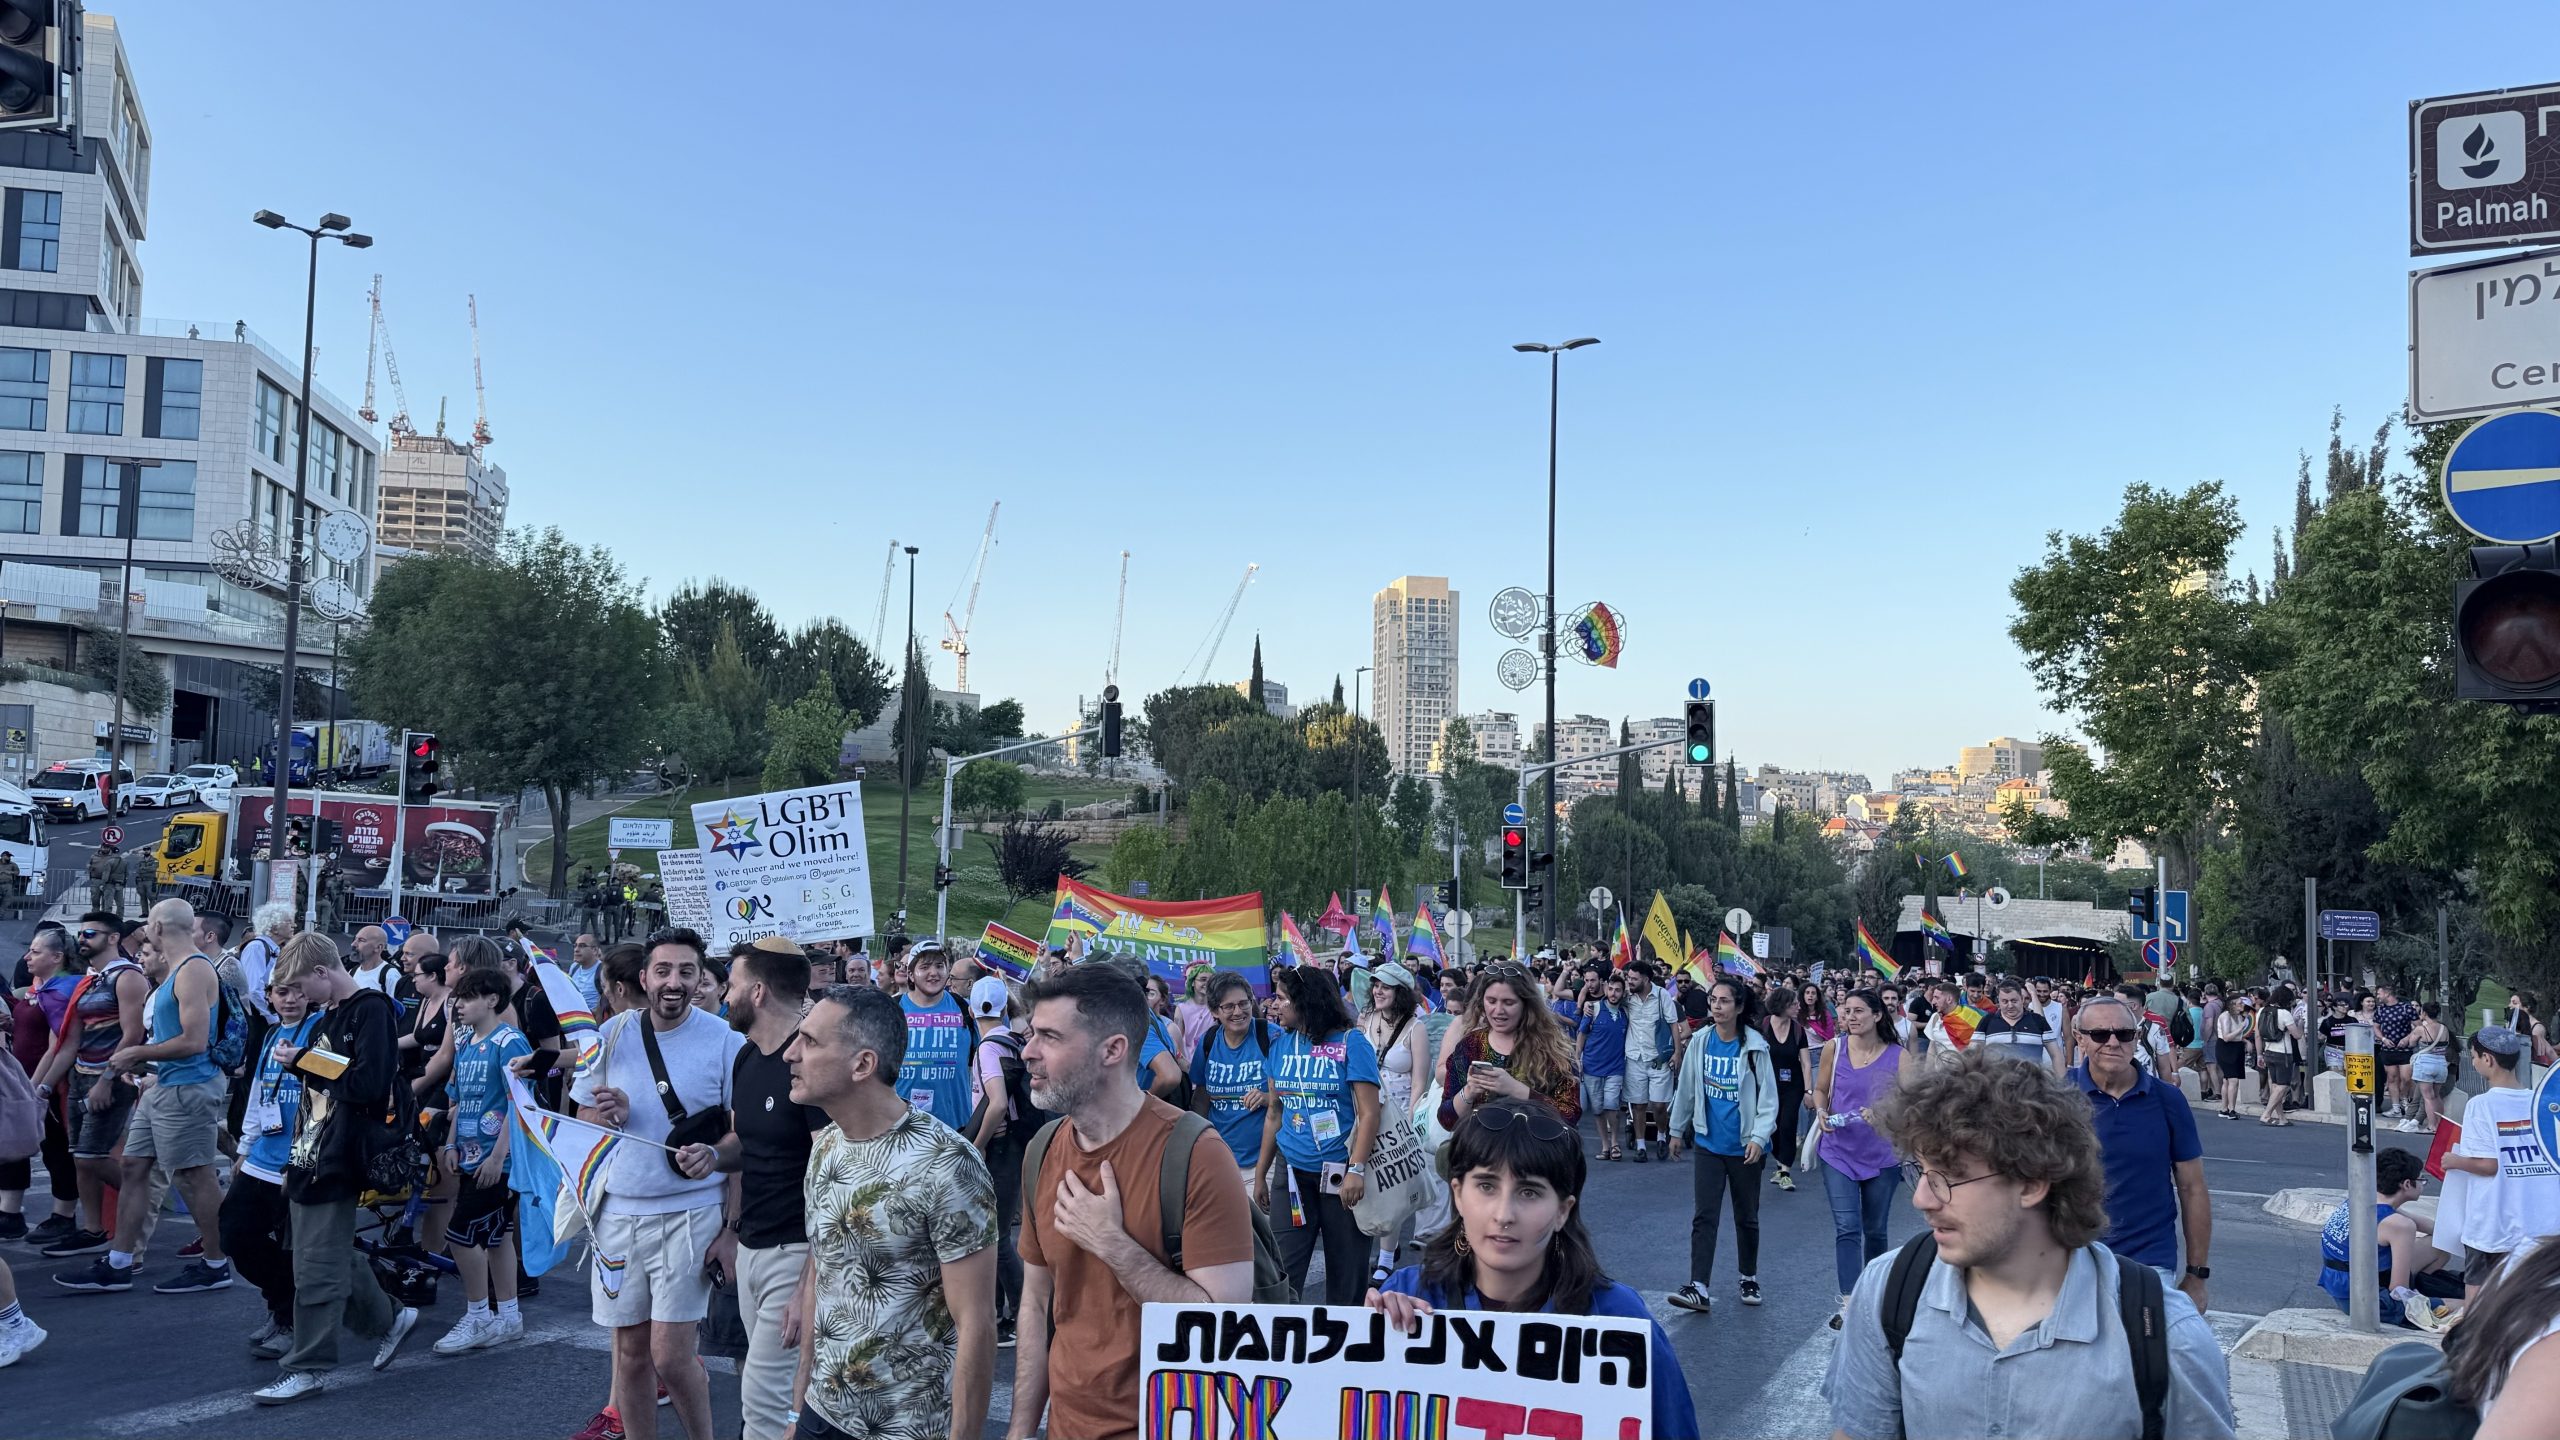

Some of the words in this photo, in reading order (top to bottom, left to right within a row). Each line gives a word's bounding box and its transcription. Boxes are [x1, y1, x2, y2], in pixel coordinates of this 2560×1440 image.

[2437, 193, 2548, 229] Palmah
[758, 791, 852, 828] LGBT
[347, 834, 384, 845] הבשרים
[354, 826, 379, 836] סדרת
[641, 837, 668, 845] Precinct
[769, 825, 849, 858] Olim
[714, 868, 740, 878] We're
[742, 865, 767, 875] queer
[769, 861, 785, 871] and
[787, 860, 801, 868] we
[803, 855, 833, 867] moved
[836, 851, 859, 862] here!
[818, 902, 837, 911] LGBT
[816, 919, 842, 928] Groups
[907, 1026, 927, 1048] דר
[931, 1026, 958, 1048] בית
[921, 1066, 956, 1080] החופש
[1236, 1060, 1262, 1083] בית
[1312, 1054, 1339, 1079] בית
[459, 1100, 481, 1113] החופ
[1368, 1153, 1388, 1170] THIS
[1386, 1142, 1410, 1161] TOWN
[2500, 1145, 2547, 1164] יחד
[1375, 1148, 1426, 1193] ARTISTS
[1157, 1307, 1386, 1364] נלחמת
[1404, 1314, 1508, 1373] אני
[1516, 1322, 1647, 1389] היום
